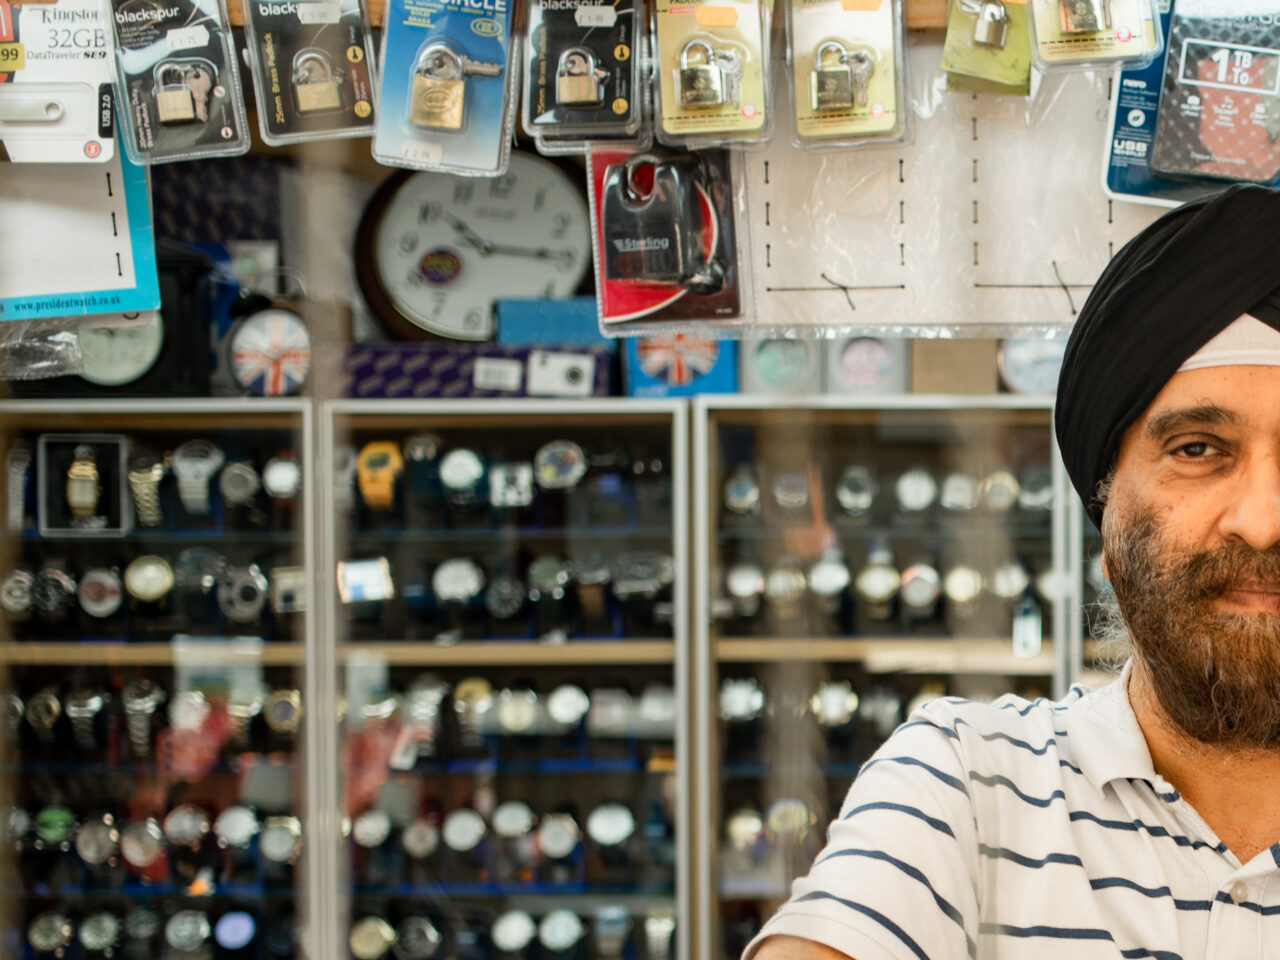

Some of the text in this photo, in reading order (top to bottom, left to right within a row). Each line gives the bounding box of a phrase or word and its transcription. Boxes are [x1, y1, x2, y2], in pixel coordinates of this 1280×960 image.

[115, 7, 180, 24] blackspur
[259, 3, 302, 17] blacks
[48, 28, 106, 48] 32GB
[264, 32, 276, 67] Padlock
[1211, 48, 1254, 82] 1 TB
[271, 68, 280, 93] Brass
[102, 94, 111, 127] USB 2.0
[623, 237, 670, 251] Sterling
[14, 294, 121, 313] www.presidentwatch.co.uk
